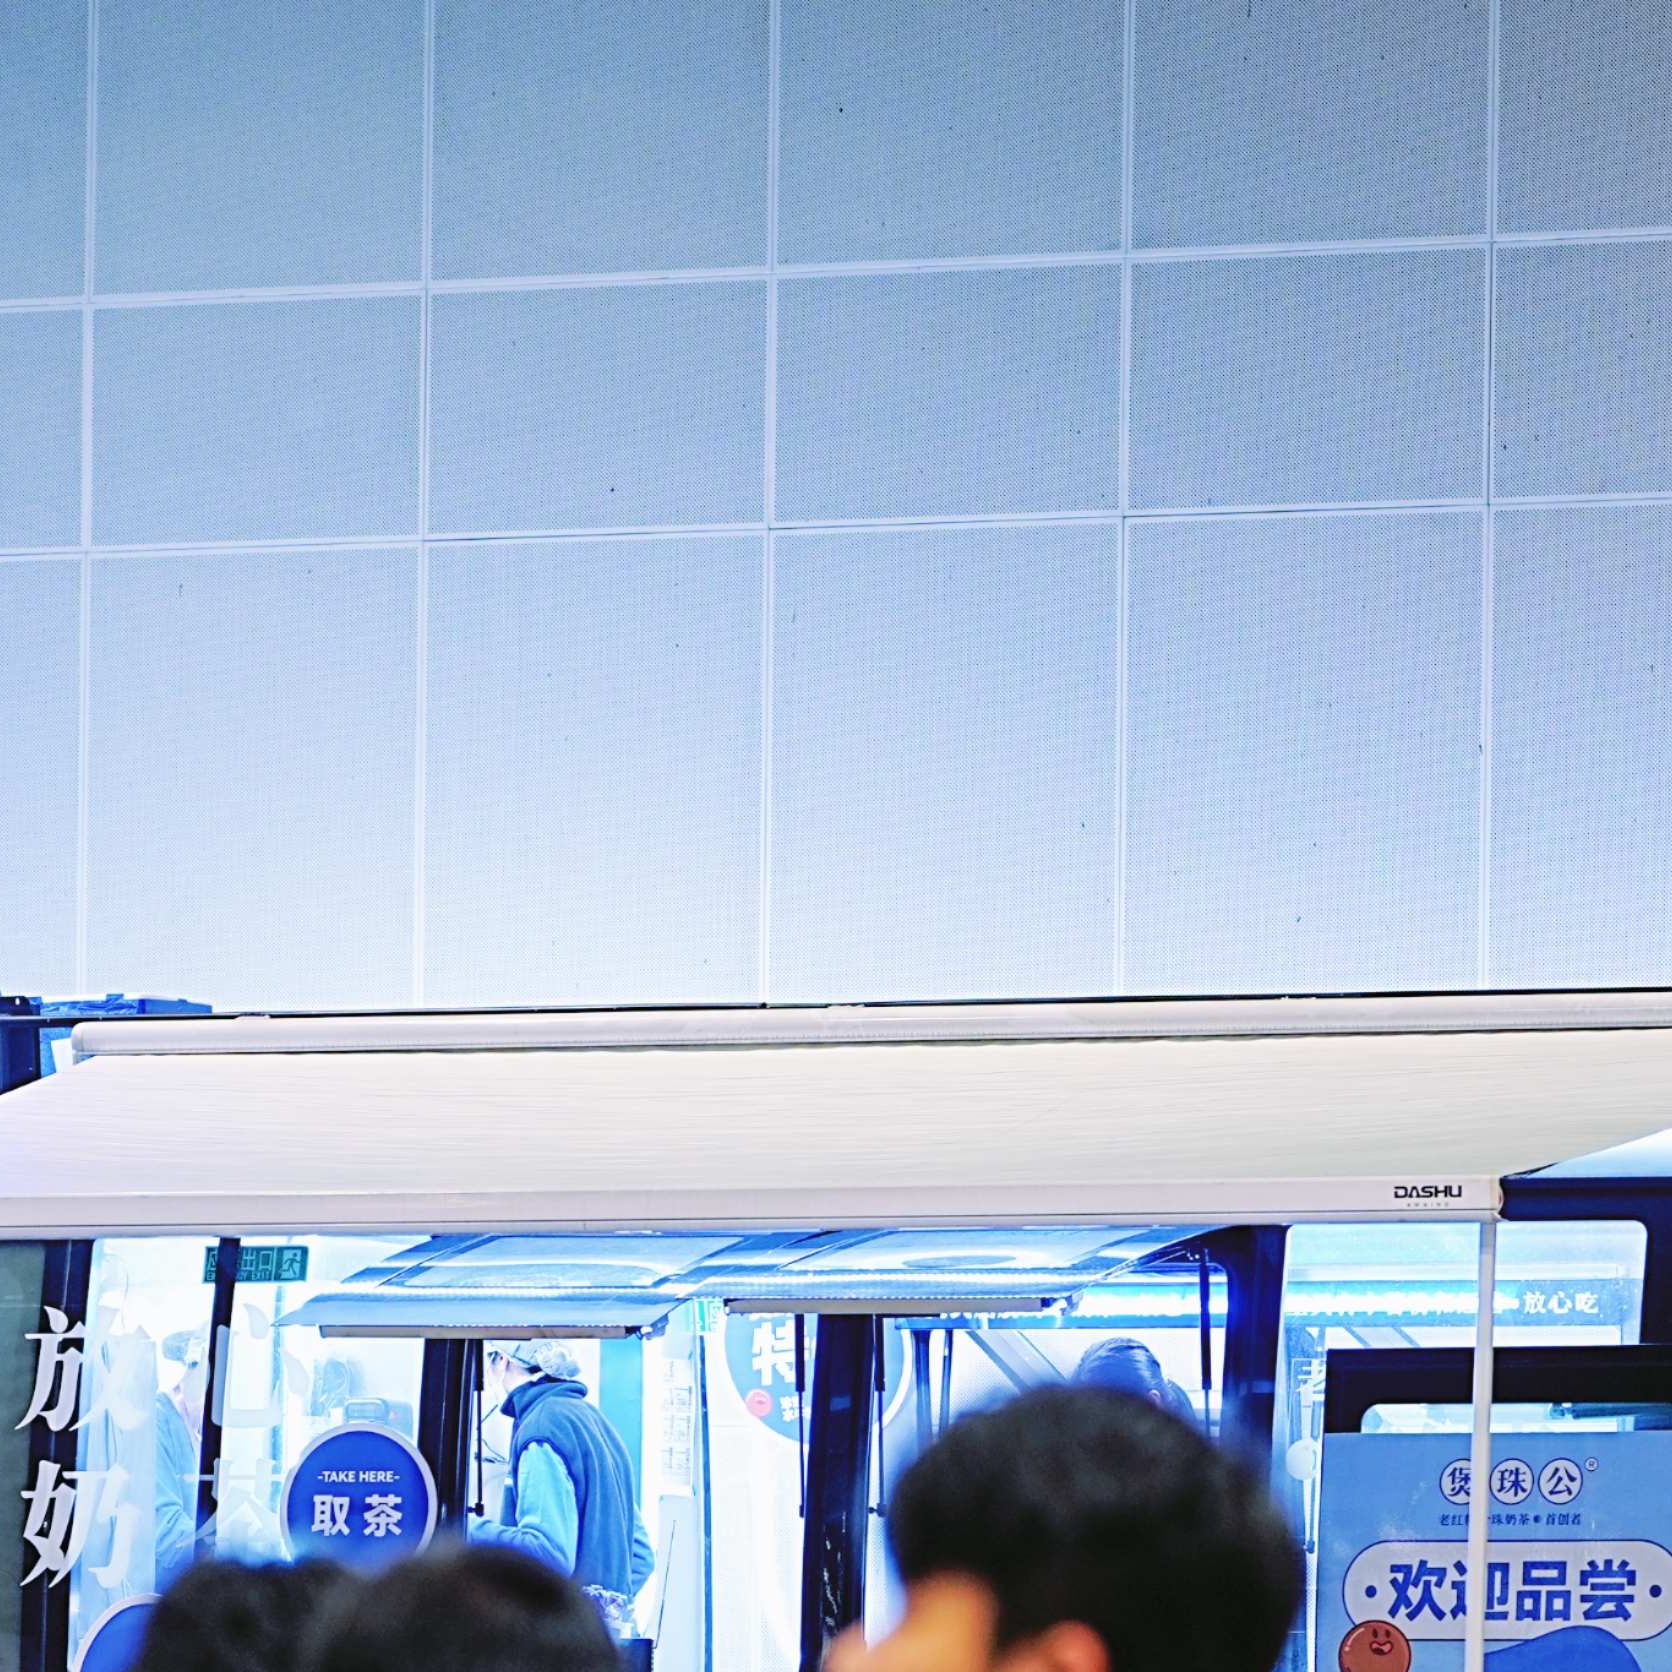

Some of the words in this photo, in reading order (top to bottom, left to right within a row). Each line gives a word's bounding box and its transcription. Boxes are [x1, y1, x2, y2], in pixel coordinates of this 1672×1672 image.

[1393, 1185, 1463, 1198] DASHU
[1523, 1290, 1599, 1315] 放心吃
[1446, 1466, 1578, 1498] 煲珠公
[312, 1494, 402, 1537] 取茶
[1386, 1558, 1637, 1622] 欢迎品尝
